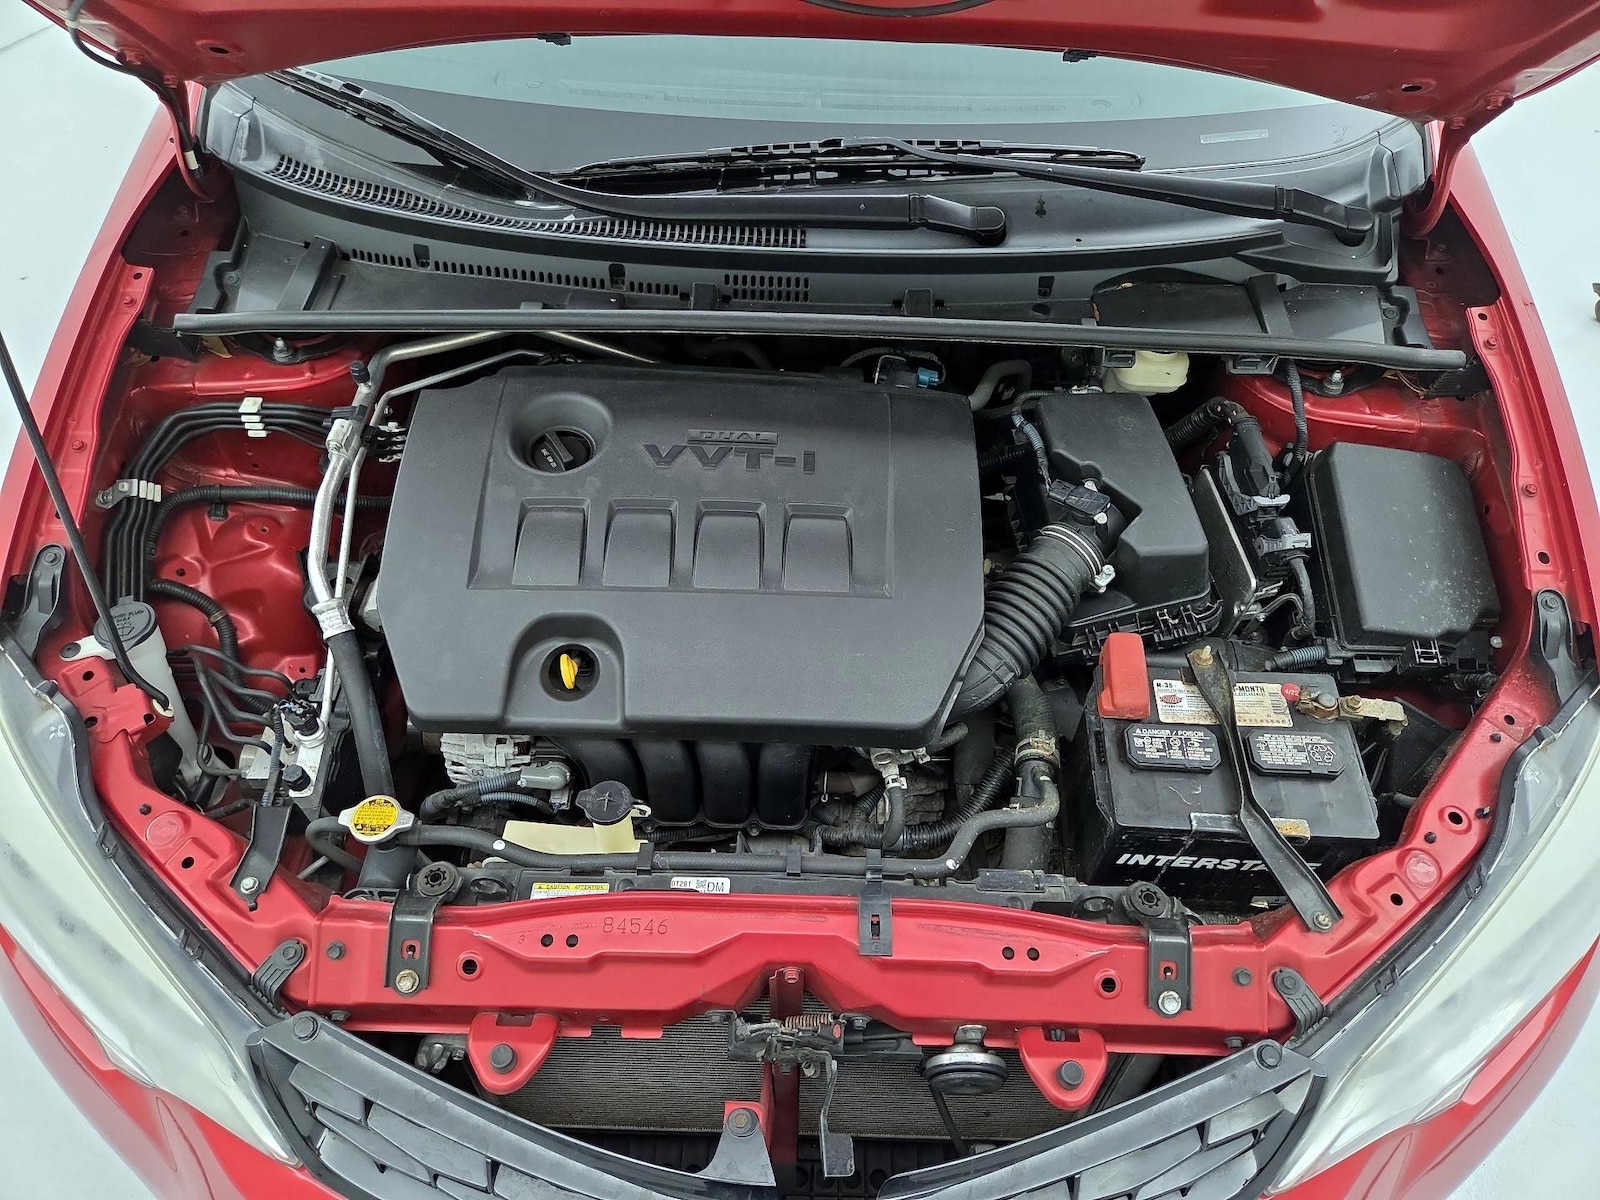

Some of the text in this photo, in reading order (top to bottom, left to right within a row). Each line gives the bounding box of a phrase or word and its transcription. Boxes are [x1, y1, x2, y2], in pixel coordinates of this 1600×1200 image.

[700, 431, 769, 442] DUAL
[1232, 685, 1265, 693] -MONTH
[1178, 730, 1204, 738] POISON
[1115, 853, 1322, 872] INTERSTA
[707, 881, 724, 892] DM
[602, 916, 669, 935] 84546
